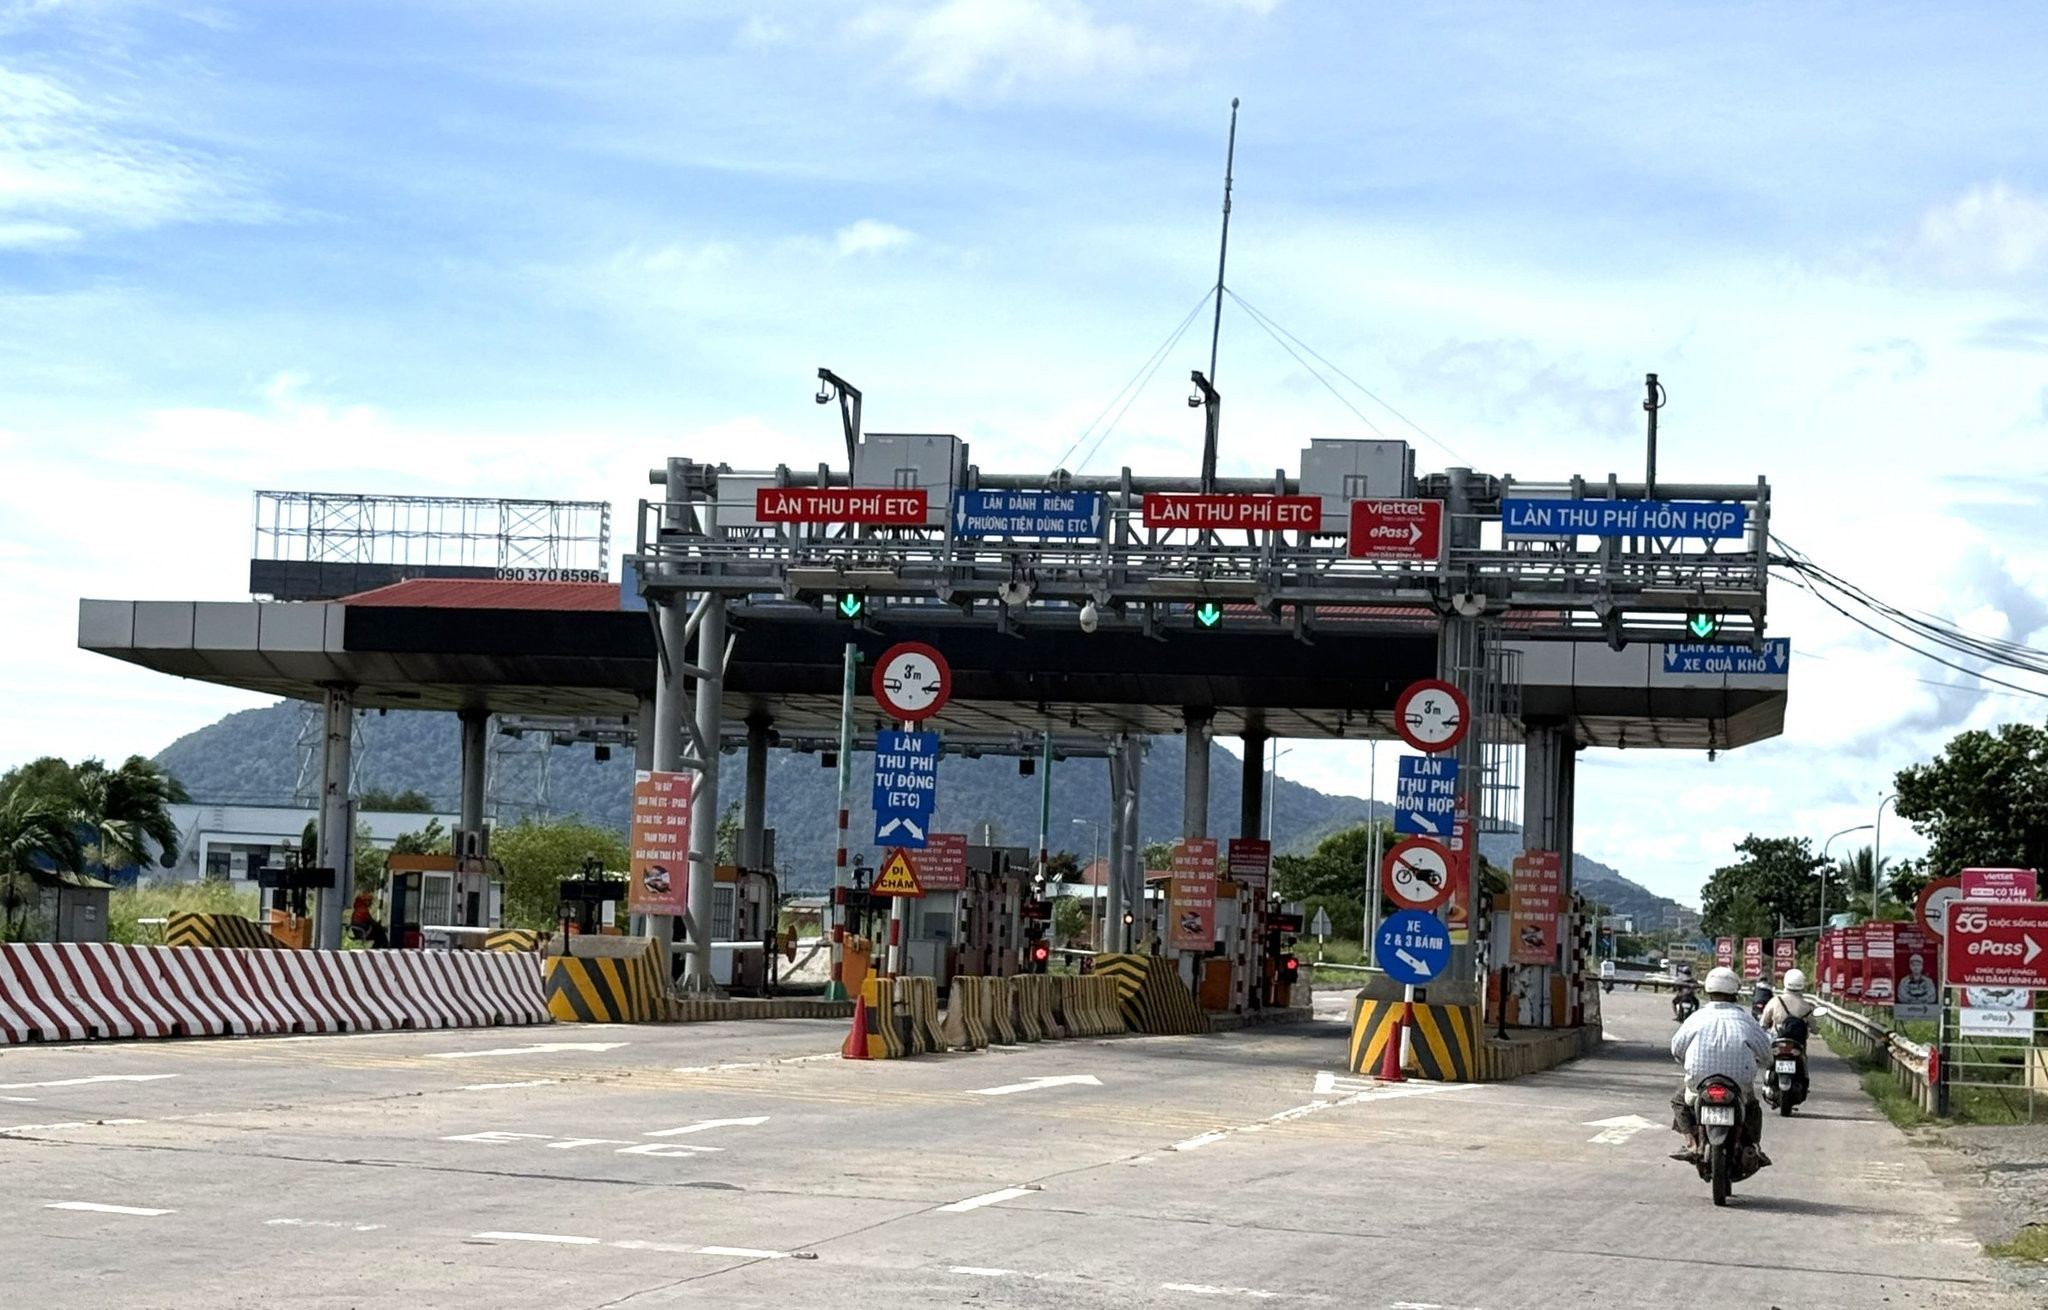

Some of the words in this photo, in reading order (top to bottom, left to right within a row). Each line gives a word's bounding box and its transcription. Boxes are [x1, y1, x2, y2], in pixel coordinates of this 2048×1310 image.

[764, 493, 801, 514] LÀN
[806, 498, 844, 514] THU
[849, 494, 881, 515] PHÍ
[885, 499, 919, 515] ETC
[983, 494, 1003, 509] LÀN
[1009, 495, 1036, 510] DÀNH
[1043, 495, 1074, 511] RIÊNG
[1150, 498, 1189, 520] LÀN
[1195, 503, 1233, 521] THU
[1240, 500, 1272, 521] PHÍ
[1277, 505, 1312, 522] ETC
[1367, 502, 1426, 515] viettel
[1010, 515, 1034, 533] TIỆN
[1037, 516, 1064, 532] DÙNG
[1068, 519, 1087, 532] ETC
[1510, 503, 1551, 526] LÀN
[1557, 509, 1598, 527] THU
[1603, 505, 1639, 528] PHÍ
[1643, 503, 1686, 529] HỖN
[1693, 511, 1736, 533] HỢP
[1369, 526, 1410, 538] ePass
[496, 568, 525, 580] 090
[528, 569, 557, 581] 370
[560, 570, 600, 583] 8596
[1683, 658, 1701, 671] XE
[894, 734, 921, 752] LÀN
[877, 754, 906, 768] THU
[910, 754, 935, 771] PHÍ
[1414, 756, 1442, 775] LÀN
[876, 772, 895, 790] TỰ
[897, 771, 934, 791] ĐỘNG
[1399, 777, 1427, 793] THU
[1431, 777, 1456, 795] PHÍ
[888, 792, 920, 809] (ETC)
[1427, 796, 1455, 816] HỢP
[1406, 920, 1421, 933] XE
[1955, 913, 1988, 933] 5G
[1384, 933, 1391, 945] 2
[1405, 935, 1412, 947] 3
[1414, 934, 1443, 950] BÁNH
[1967, 939, 2023, 956] ePass
